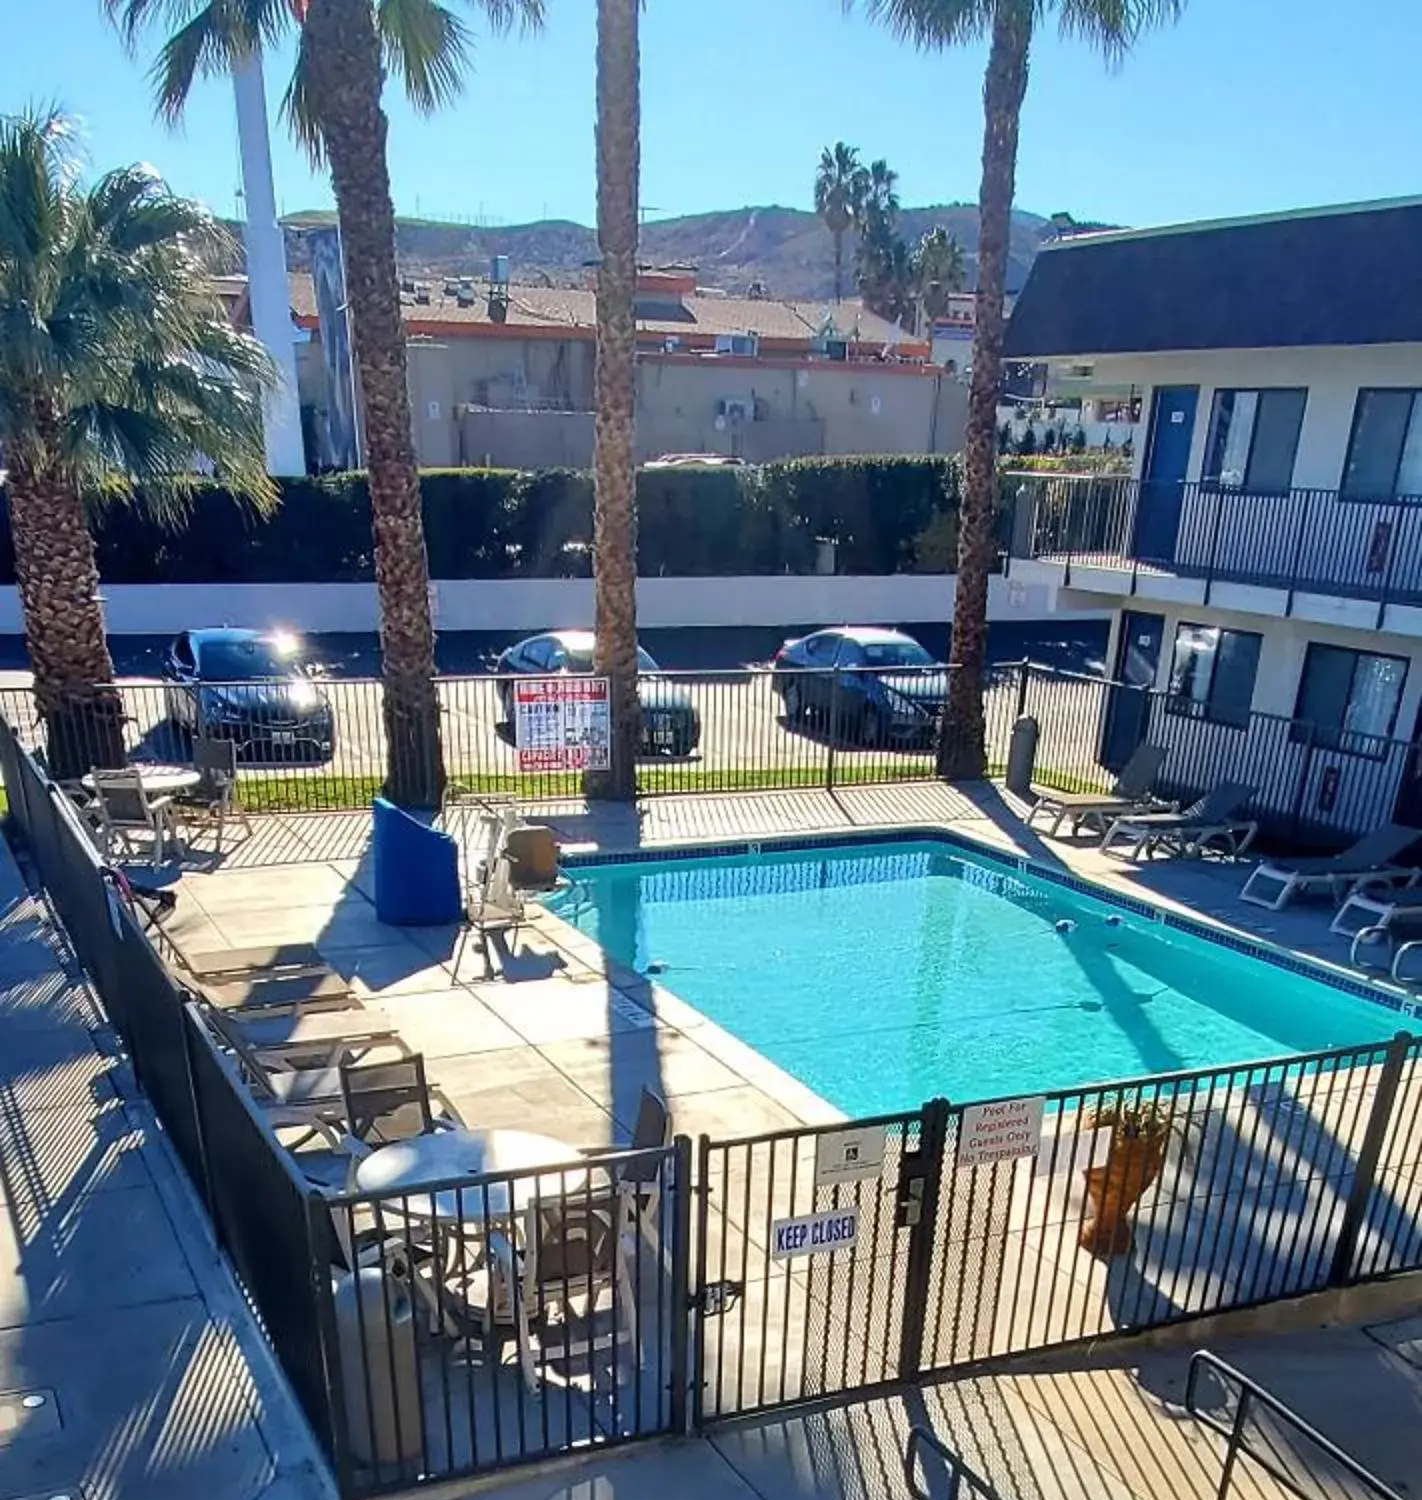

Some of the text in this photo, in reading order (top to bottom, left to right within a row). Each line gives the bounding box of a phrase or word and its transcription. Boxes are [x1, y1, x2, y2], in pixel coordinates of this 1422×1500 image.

[1008, 1102, 1026, 1112] For
[975, 1116, 1029, 1132] Registered
[969, 1131, 1031, 1148] Guests Only
[960, 1151, 975, 1162] No
[777, 1215, 855, 1251] KEEP CLOSED
